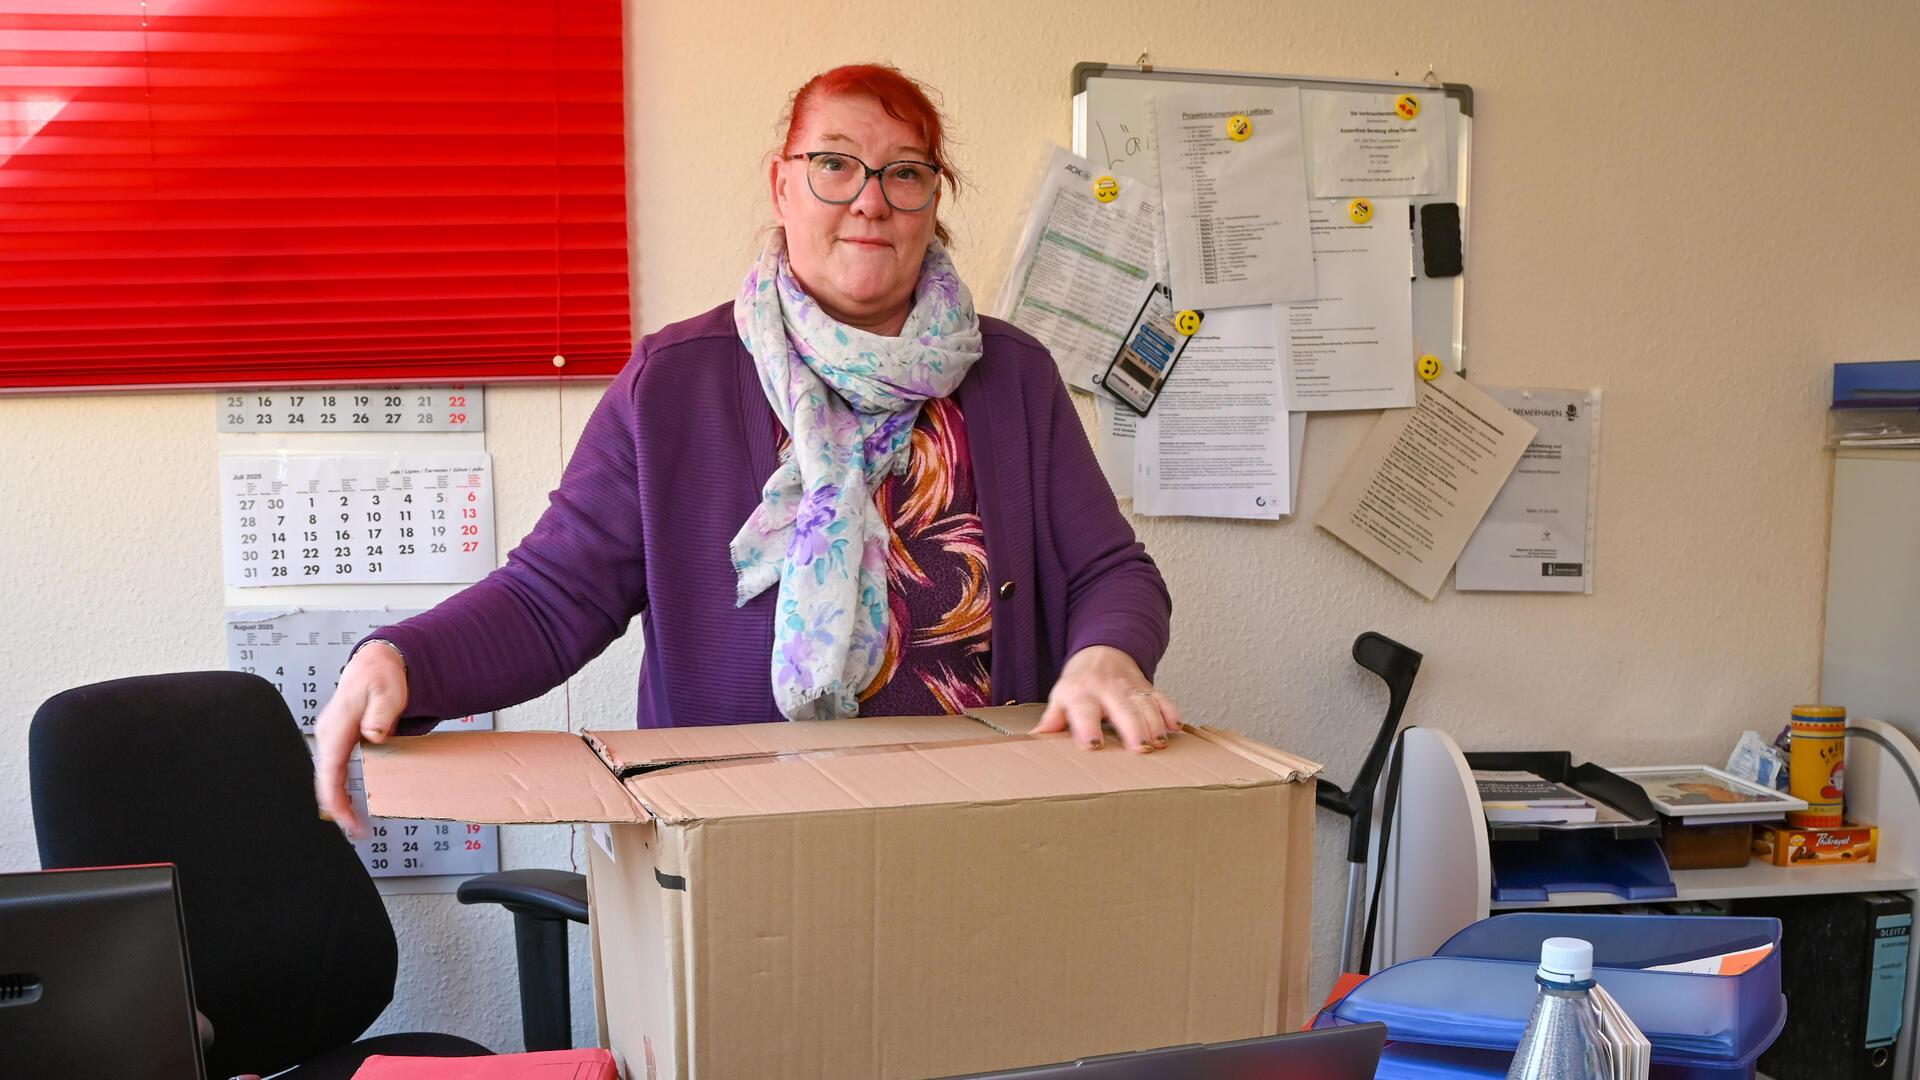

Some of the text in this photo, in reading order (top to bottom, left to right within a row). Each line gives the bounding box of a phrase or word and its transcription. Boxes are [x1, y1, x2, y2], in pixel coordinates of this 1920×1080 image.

[1064, 163, 1083, 177] AOK
[228, 396, 465, 408] 25 16 17 18 19 20 21 22
[228, 413, 466, 424] 26 23 24 25 26 27 28 29
[240, 491, 476, 510] 27 30 1 2 3 4 5 6
[240, 508, 477, 527] 28 7 8 9 10 11 12 13
[241, 525, 478, 544] 29 14 15 16 17 18 19 20
[242, 541, 479, 561] 30 21 22 23 24 25 26 27
[244, 562, 382, 578] 31 28 29 30 31
[240, 650, 254, 660] 31
[276, 666, 284, 676] 4
[308, 666, 316, 676] 5
[302, 682, 317, 693] 12
[303, 699, 317, 709] 19
[301, 715, 317, 726] 26
[373, 824, 481, 837] 16 17 18 19
[371, 840, 481, 853] 23 24 25 26
[372, 858, 418, 869] 30 31
